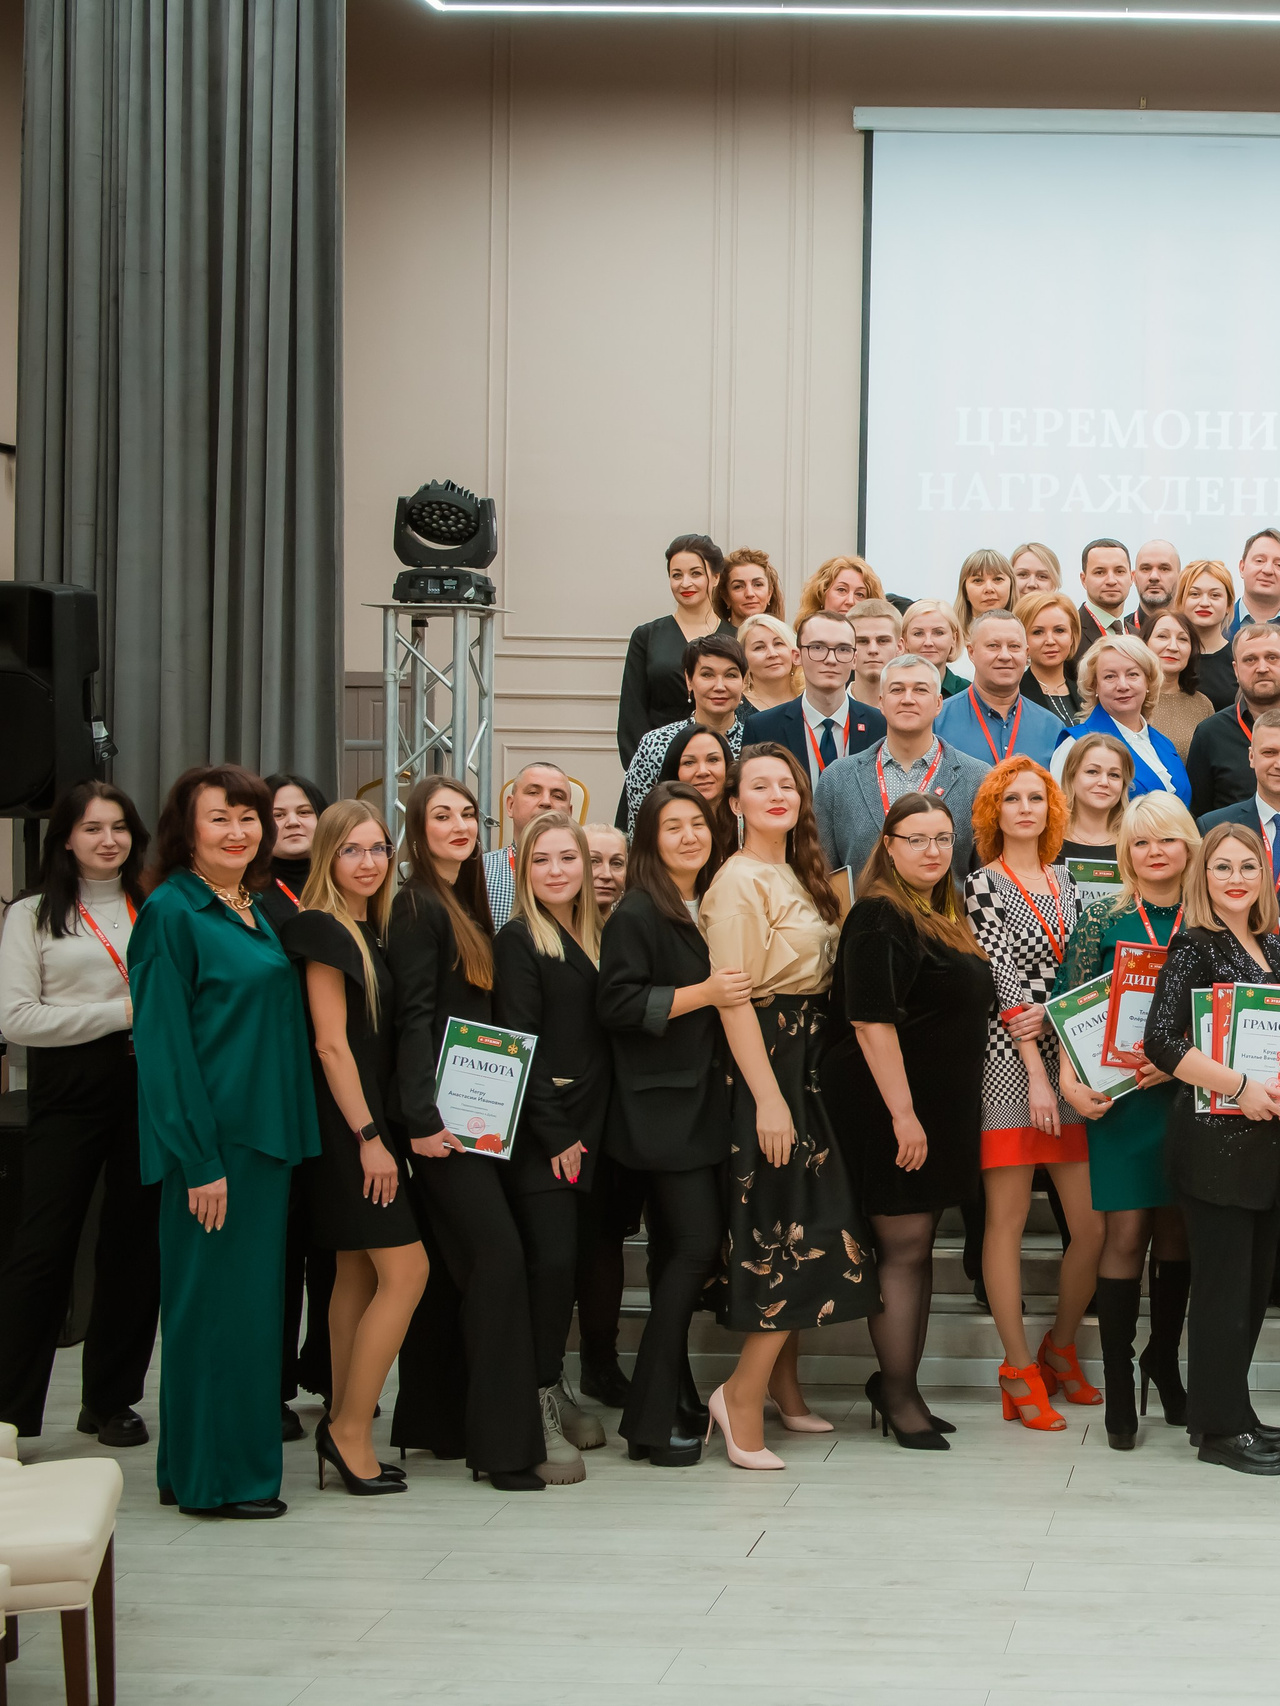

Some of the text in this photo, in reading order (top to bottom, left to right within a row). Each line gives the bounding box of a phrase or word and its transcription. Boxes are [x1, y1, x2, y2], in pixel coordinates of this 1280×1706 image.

[1122, 973, 1157, 987] ДИП
[1070, 1010, 1108, 1037] ГРАМО
[452, 1054, 515, 1078] ГРАМОТА
